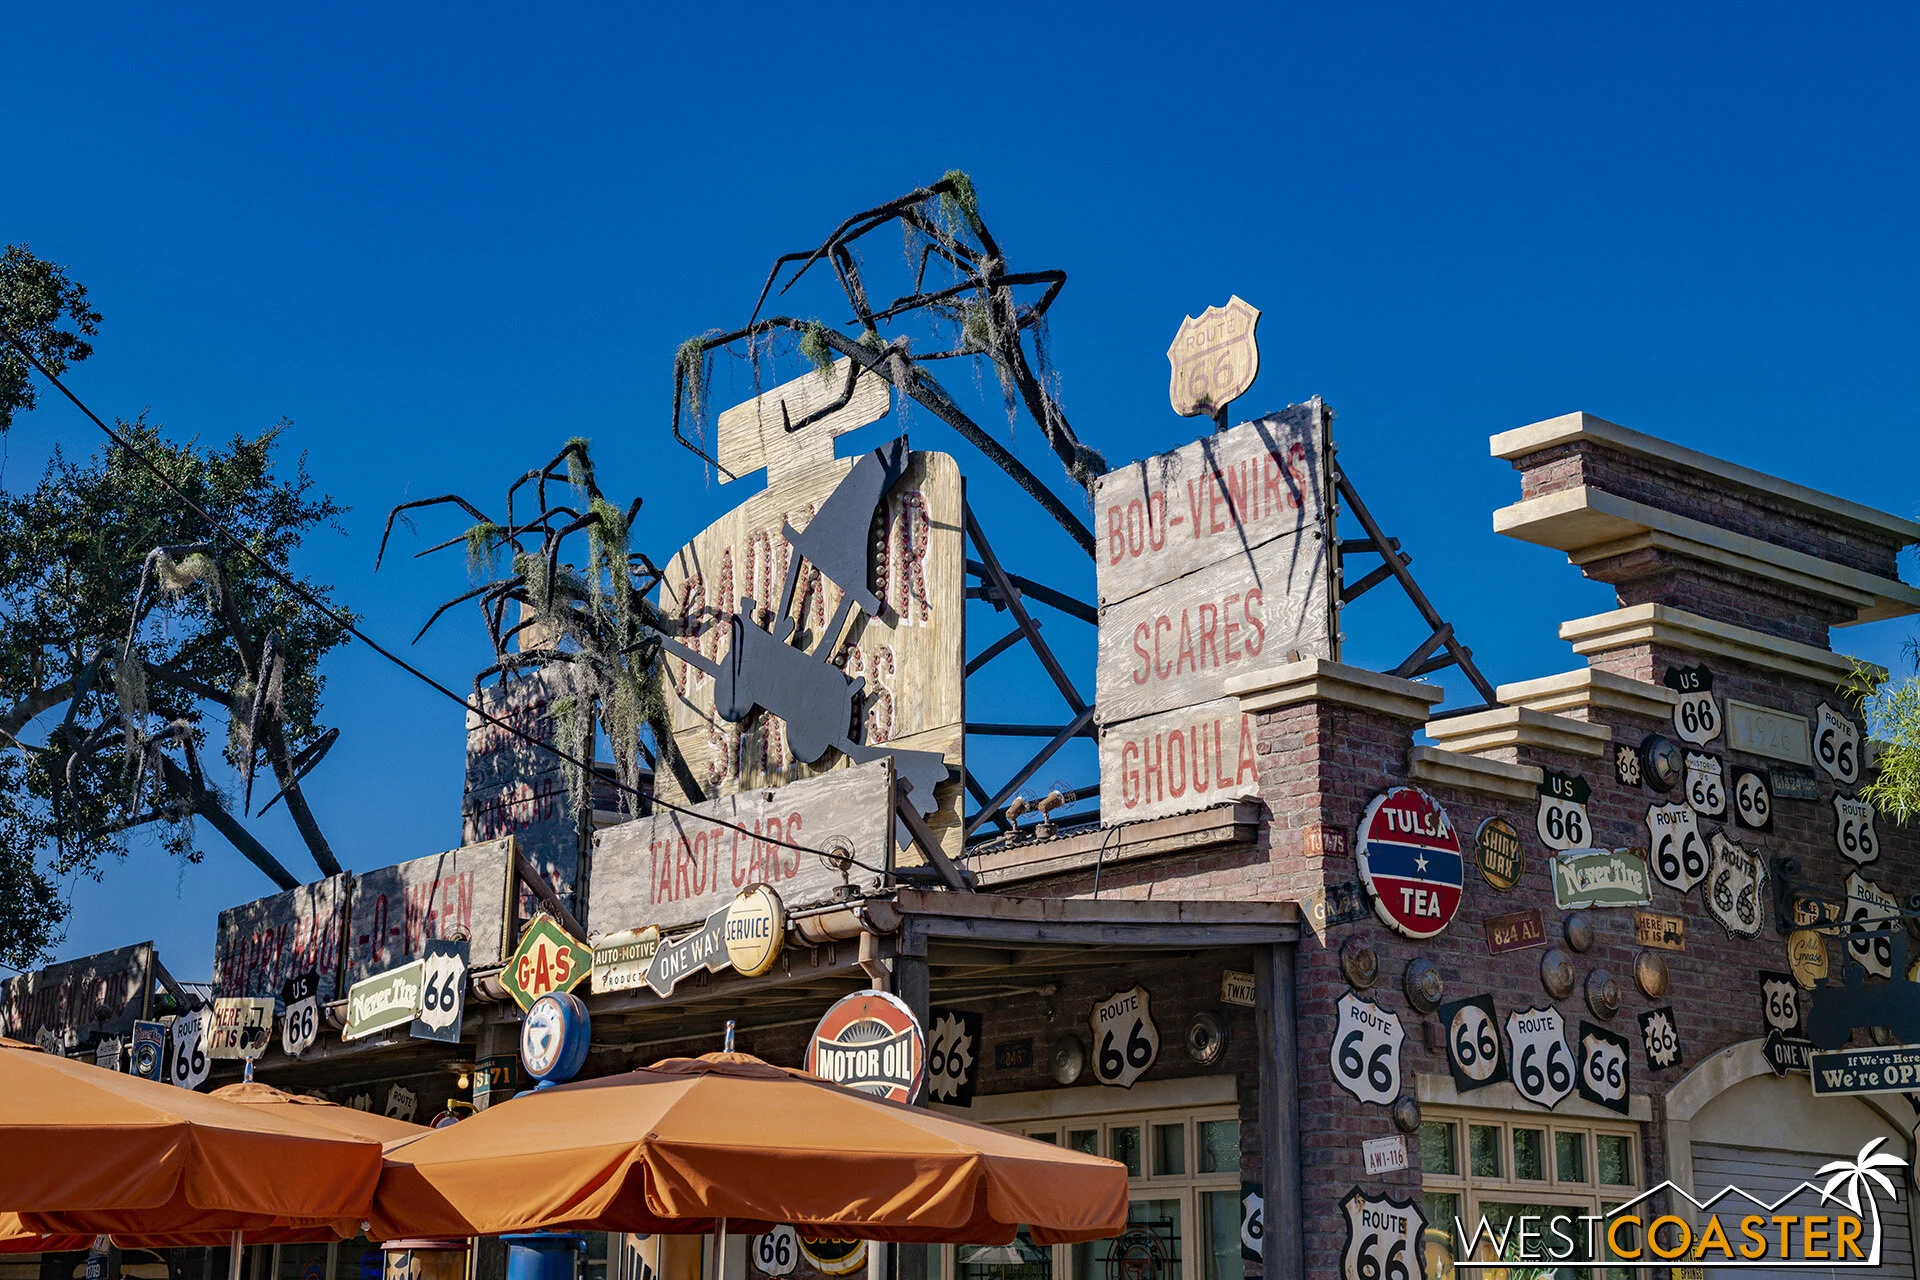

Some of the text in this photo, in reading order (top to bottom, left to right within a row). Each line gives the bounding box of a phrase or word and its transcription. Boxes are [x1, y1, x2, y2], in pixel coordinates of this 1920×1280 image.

[1186, 316, 1236, 350] ROUTE
[1187, 349, 1235, 397] 66
[1108, 441, 1308, 566] BOO-VENIRS
[1132, 587, 1265, 686] SCARES
[1680, 672, 1700, 689] US
[1681, 699, 1714, 733] 66
[1825, 712, 1852, 738] ROUTE
[1620, 756, 1637, 776] 66
[1820, 728, 1853, 777] 66
[1552, 777, 1574, 797] US
[1692, 780, 1719, 808] 66
[1739, 783, 1767, 815] 66
[1382, 807, 1451, 841] TULSA
[1546, 805, 1582, 845] 66
[1657, 810, 1689, 826] ROUTE
[1842, 803, 1868, 819] ROUTE
[1482, 827, 1519, 860] SHINY
[1843, 820, 1872, 855] 66
[649, 826, 726, 905] TAROT
[731, 812, 802, 889] CARS
[1485, 854, 1514, 878] WAX
[1658, 832, 1704, 882] 66
[1720, 848, 1756, 878] ROUTE
[1400, 887, 1443, 919] TEA
[1713, 869, 1755, 926] 66
[1857, 884, 1890, 913] ROUTE
[726, 916, 770, 941] SERVICE
[1639, 916, 1662, 931] HERE
[1640, 930, 1662, 942] IT IS
[222, 923, 288, 998] HAPPY
[595, 942, 656, 965] AUTO-MOTIVE
[660, 926, 722, 981] ONE WAY
[293, 978, 308, 1000] US
[424, 973, 456, 1013] 66
[1770, 990, 1794, 1018] 66
[215, 1007, 241, 1027] HERE
[290, 1006, 313, 1044] 66
[1100, 995, 1140, 1023] ROUTE
[1350, 1005, 1392, 1036] ROUTE
[1518, 1016, 1555, 1034] ROUTE
[177, 1017, 203, 1038] ROUTE
[211, 1029, 238, 1048] IT IS
[1455, 1018, 1496, 1066] 66
[1651, 1027, 1673, 1053] 66
[176, 1034, 205, 1081] 66
[819, 1038, 911, 1083] MOTOR OIL
[929, 1034, 964, 1079] 66
[1100, 1017, 1153, 1081] 66
[1338, 1029, 1392, 1093] 66
[1774, 1044, 1800, 1066] ONE
[1847, 1057, 1858, 1067] If
[1858, 1055, 1891, 1066] We're
[1520, 1040, 1571, 1096] 66
[1590, 1050, 1621, 1089] 66
[1822, 1068, 1880, 1088] We're
[393, 1090, 413, 1108] ROUTE
[1361, 1208, 1407, 1235] ROUTE
[760, 1232, 791, 1266] 66
[1356, 1233, 1409, 1280] 66
